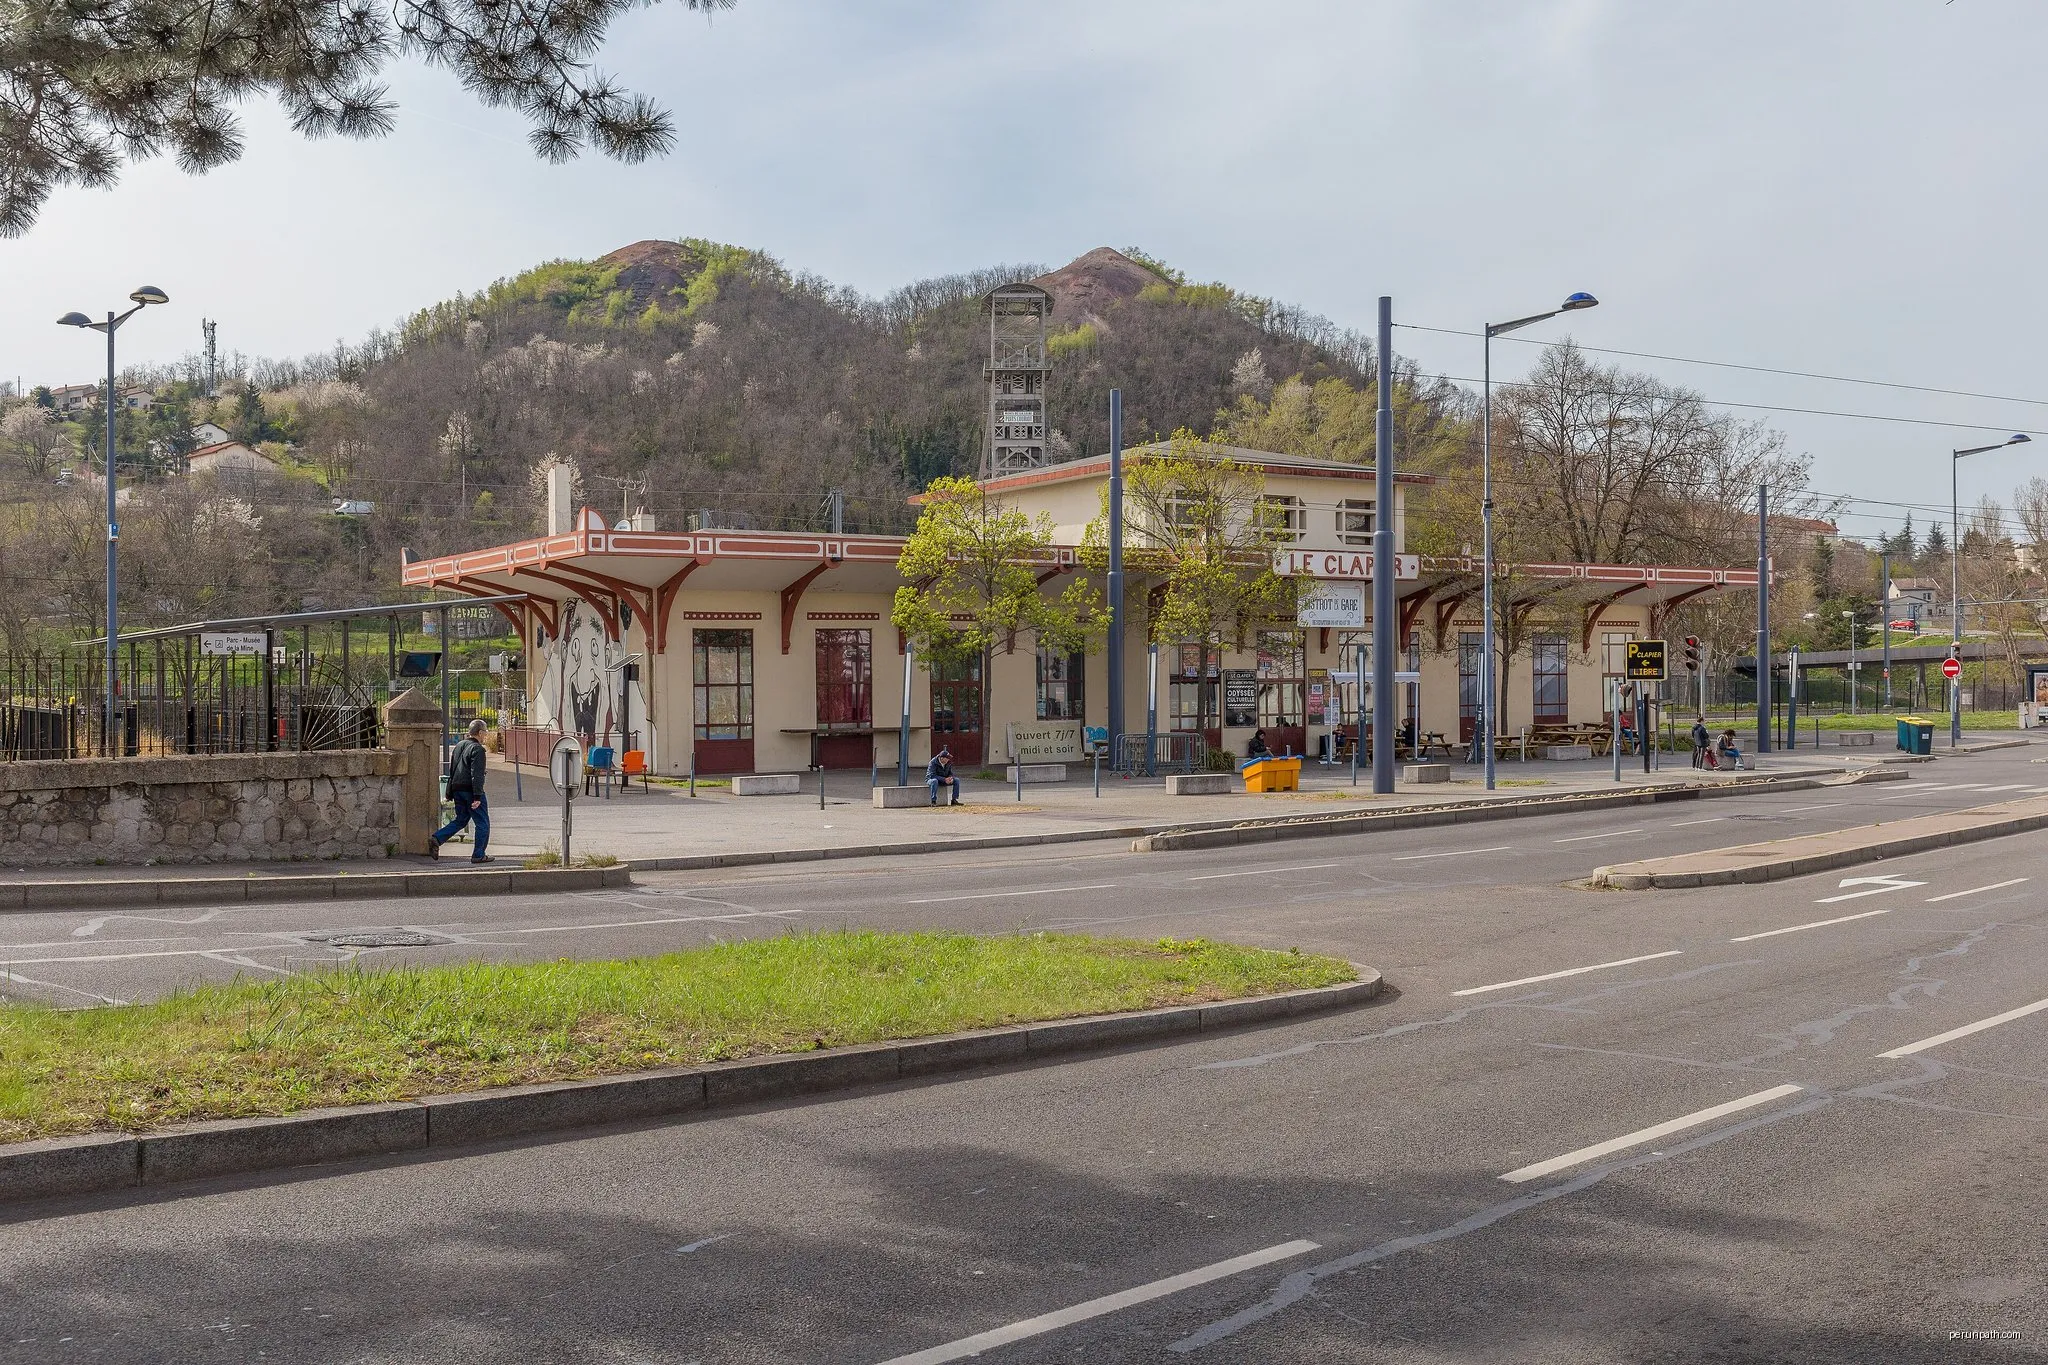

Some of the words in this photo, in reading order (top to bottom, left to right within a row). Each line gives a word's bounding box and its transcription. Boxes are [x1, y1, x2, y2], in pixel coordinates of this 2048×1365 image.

[1290, 554, 1313, 574] LE
[1324, 555, 1403, 577] CLAPR
[1303, 599, 1333, 611] ISTROT
[1341, 599, 1358, 611] GARE
[1633, 668, 1658, 676] LIBRE
[1227, 688, 1255, 697] ODYSSÉE
[1015, 730, 1051, 741] ouvert
[1056, 730, 1075, 742] 7j/7
[1020, 746, 1040, 755] midi
[1044, 746, 1053, 754] et
[1056, 745, 1074, 754] soir
